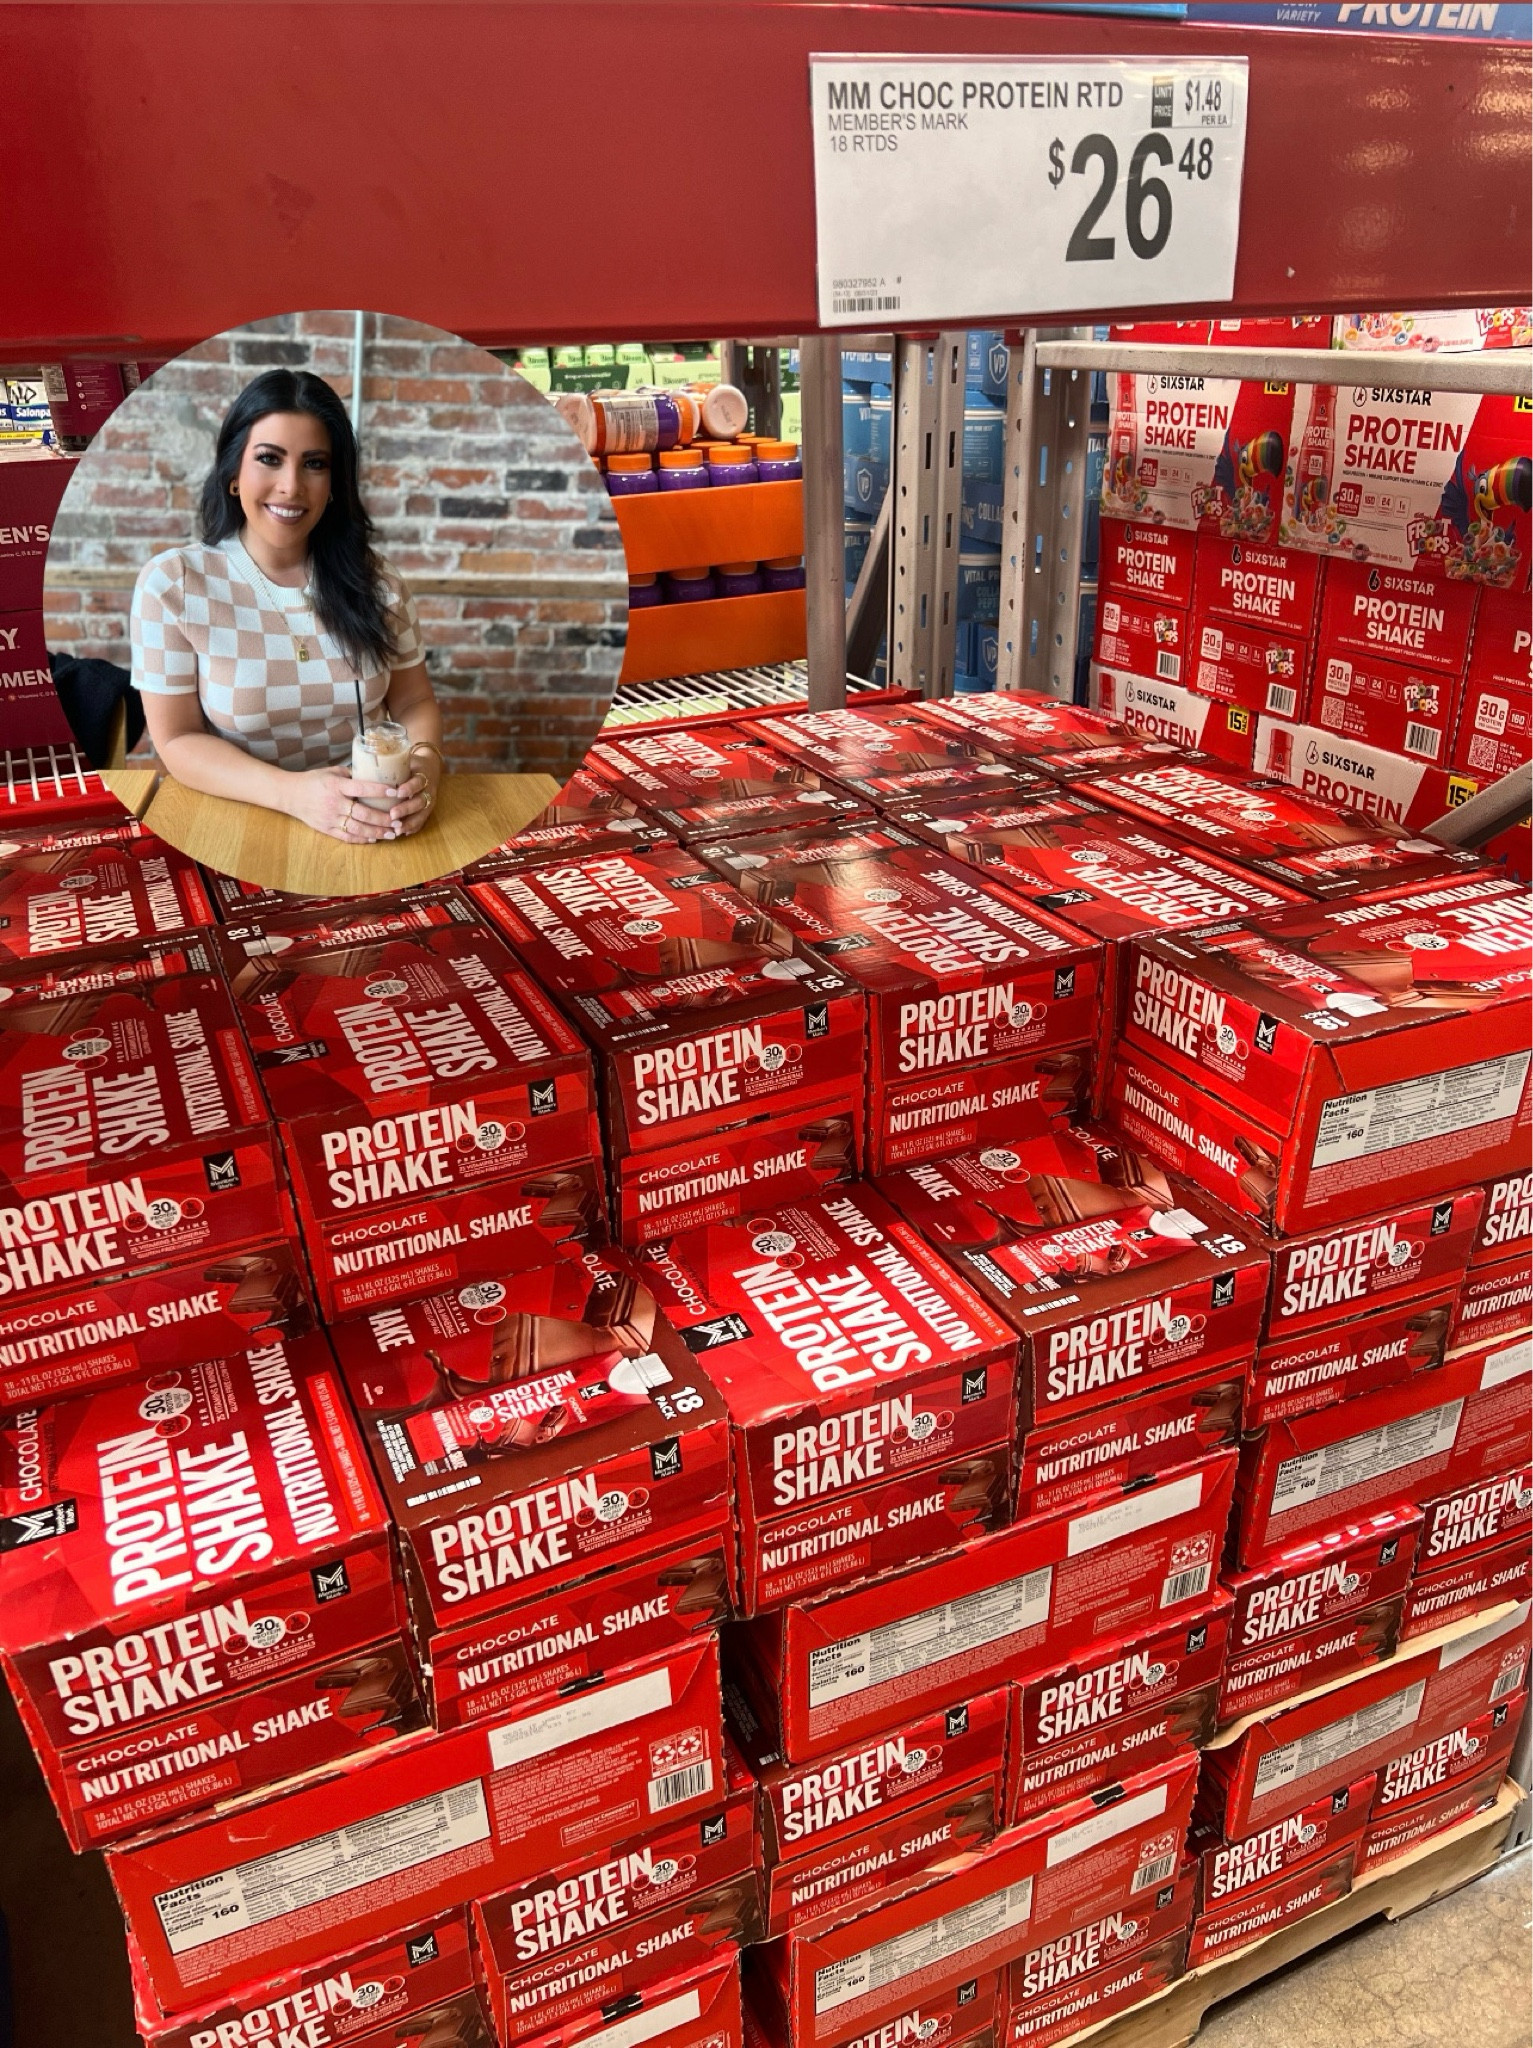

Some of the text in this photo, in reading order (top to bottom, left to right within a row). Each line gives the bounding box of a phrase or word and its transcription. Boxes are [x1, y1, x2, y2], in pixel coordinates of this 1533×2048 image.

[1276, 9, 1321, 23] VARIETY
[1337, 3, 1499, 30] PROTEIN
[828, 81, 1123, 110] MM CHOC PROTEIN RTD
[1153, 88, 1173, 99] UNIT
[1153, 105, 1173, 117] PRICE
[1185, 80, 1222, 114] $1.48
[828, 113, 968, 131] MEMBER'S MARK
[1202, 115, 1227, 125] PER EA
[829, 135, 898, 152] 18 RTDS
[993, 353, 1006, 365] VP
[1160, 376, 1205, 391] SIXSTAR
[1372, 387, 1432, 406] SIXSTAR
[16, 408, 51, 420] Salonpa
[1146, 400, 1228, 430] PROTEIN
[1347, 414, 1464, 452] PROTEIN
[1144, 426, 1196, 449] SHAKE
[1344, 445, 1417, 474] SHAKE
[0, 525, 50, 544] EN'S
[1135, 530, 1169, 545] SIXSTAR
[964, 570, 986, 584] VITAL
[1117, 547, 1176, 574] PROTEIN
[1245, 552, 1287, 568] SIXSTAR
[1126, 569, 1164, 590] SHAKE
[1221, 568, 1295, 601] PROTEIN
[1384, 576, 1435, 596] SIXSTAR
[1233, 592, 1280, 616] SHAKE
[1353, 595, 1444, 631] PROTEIN
[1136, 689, 1176, 712] SIXSTAR
[1228, 710, 1243, 729] 15
[1124, 705, 1197, 747] PROTEIN
[1322, 751, 1375, 780] SIXSTAR
[1302, 768, 1403, 823] PROTEIN
[1448, 784, 1467, 807] 15
[582, 857, 681, 920] PROTEIN
[773, 894, 836, 937] CHOCOLATE
[666, 967, 736, 996] PROTEIN
[813, 973, 845, 991] 18
[1137, 953, 1226, 1028] PROTEIN
[900, 986, 1014, 1039] PROTEIN
[1132, 992, 1201, 1059] SHAKE
[338, 999, 435, 1095] PROTEIN
[398, 1002, 498, 1080] SHAKE
[634, 1025, 766, 1091] PROTEIN
[898, 1026, 989, 1074] SHAKE
[637, 1069, 741, 1125] SHAKE
[1128, 1065, 1180, 1109] CHOCOLATE
[1324, 1093, 1368, 1110] Nutrition
[1324, 1106, 1350, 1119] Facts
[322, 1100, 479, 1171] PROTEIN
[1124, 1086, 1239, 1178] NUTRITIONAL SHAKE
[1346, 1127, 1365, 1141] 160
[328, 1147, 454, 1209] SHAKE
[0, 1176, 149, 1250] ROTEIN
[330, 1212, 428, 1246] CHOCOLATE
[469, 1205, 533, 1239] SHAKE
[1051, 1220, 1123, 1244] PROTEIN
[1062, 1233, 1115, 1256] SHAKE
[1200, 1239, 1227, 1259] PACK
[1213, 1234, 1247, 1254] 18
[1288, 1223, 1398, 1283] PROTEIN
[582, 1253, 618, 1292] OLATE
[647, 1244, 707, 1315] CHOCOLATE
[1281, 1264, 1368, 1316] SHAKE
[0, 1301, 97, 1333] HOCOLATE
[0, 1291, 222, 1368] NUTRITIONAL SHAKE
[733, 1260, 877, 1393] PROTEIN
[806, 1264, 932, 1373] SHAKE
[1049, 1297, 1174, 1368] PROTEIN
[490, 1370, 577, 1409] PROTEIN
[1046, 1347, 1144, 1403] SHAKE
[496, 1389, 568, 1424] SHAKE
[654, 1395, 678, 1421] PACK
[669, 1386, 704, 1414] 18
[247, 1342, 340, 1545] NUTRITIONAL SHAKE
[773, 1393, 914, 1470] PROTEIN
[1035, 1413, 1197, 1485] NUTRITIONAL SHAKE
[1040, 1421, 1117, 1457] CHOCOLATE
[16, 1408, 43, 1502] CHOCOLATE
[773, 1440, 885, 1507] SHAKE
[98, 1428, 193, 1606] PROTEIN
[176, 1431, 274, 1575] SHAKE
[430, 1472, 600, 1566] PROTEIN
[1432, 1475, 1524, 1532] PROTEIN
[1427, 1509, 1501, 1558] SHAKE
[439, 1524, 572, 1602] SHAKE
[1246, 1561, 1349, 1618] PROTEIN
[1411, 1561, 1527, 1618] NUTRITIONAL SHAKE
[1417, 1570, 1474, 1598] CHOCOLATE
[456, 1614, 559, 1660] CHOCOLATE
[1242, 1596, 1324, 1646] SHAKE
[49, 1598, 250, 1699] PROTEIN
[458, 1594, 670, 1690] NUTRITIONAL SHAKE
[810, 1636, 863, 1660] Nutrition
[811, 1651, 843, 1669] Facts
[844, 1664, 866, 1680] 160
[1040, 1651, 1151, 1717] PROTEIN
[63, 1652, 223, 1736] SHAKE
[1038, 1690, 1124, 1745] SHAKE
[77, 1723, 199, 1772] CHOCOLATE
[81, 1696, 333, 1802] NUTRITIONAL SHAKE
[1385, 1728, 1469, 1785] PROTEIN
[1381, 1760, 1448, 1805] SHAKE
[1213, 1814, 1304, 1875] PROTEIN
[1367, 1798, 1471, 1858] NUTRITIONAL SHAKE
[1371, 1813, 1425, 1840] CHOCOLATE
[157, 1874, 225, 1904] Nutrition
[1212, 1853, 1284, 1899] SHAKE
[159, 1892, 203, 1912] Facts
[211, 1903, 241, 1920] 160
[1204, 1884, 1323, 1950] NUTRITIONAL SHAKE
[1207, 1903, 1267, 1931] CHOCOLATE
[190, 1971, 355, 2048] PROTEIN
